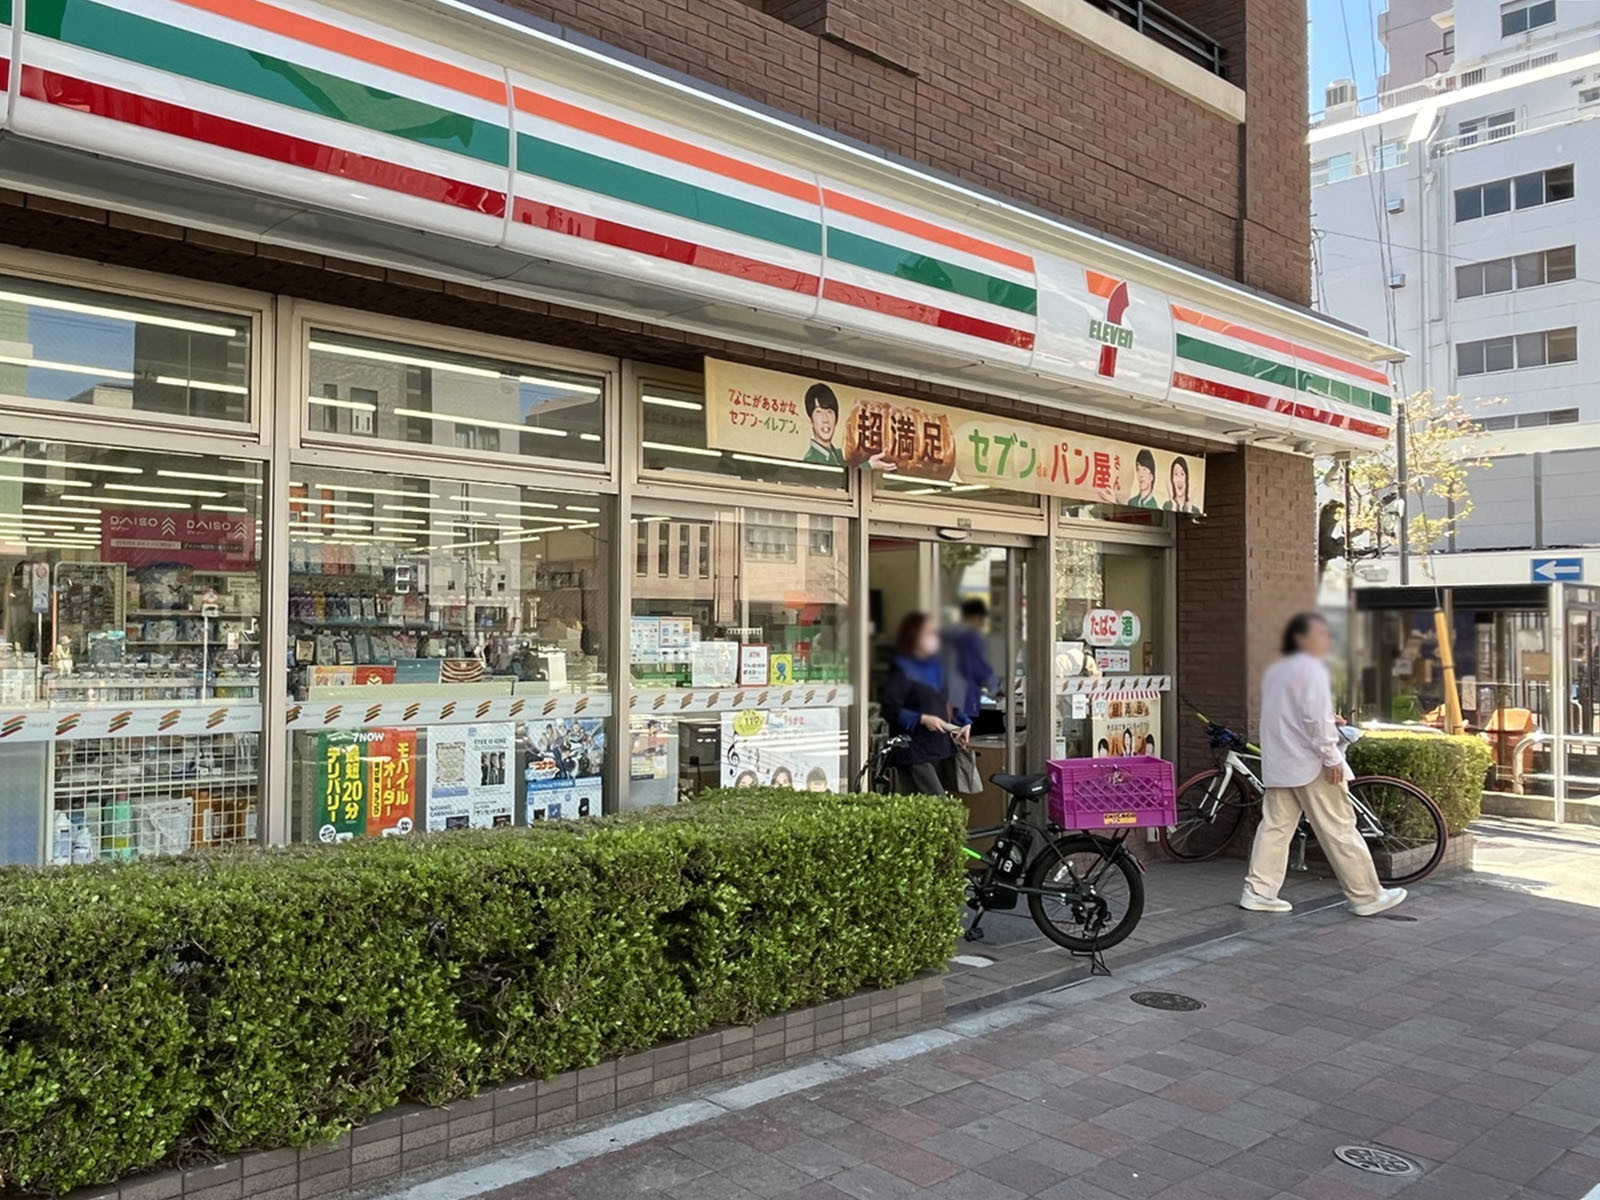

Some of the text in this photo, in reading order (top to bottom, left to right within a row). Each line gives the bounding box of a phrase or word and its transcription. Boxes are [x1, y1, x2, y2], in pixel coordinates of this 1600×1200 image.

[857, 408, 944, 465] 超満足
[110, 515, 158, 527] DAISO
[187, 519, 231, 531] DAISO
[1090, 615, 1117, 636] たばこ
[1121, 615, 1133, 637] 酒
[351, 732, 385, 743] 7NOW
[326, 746, 341, 823] デリバリー
